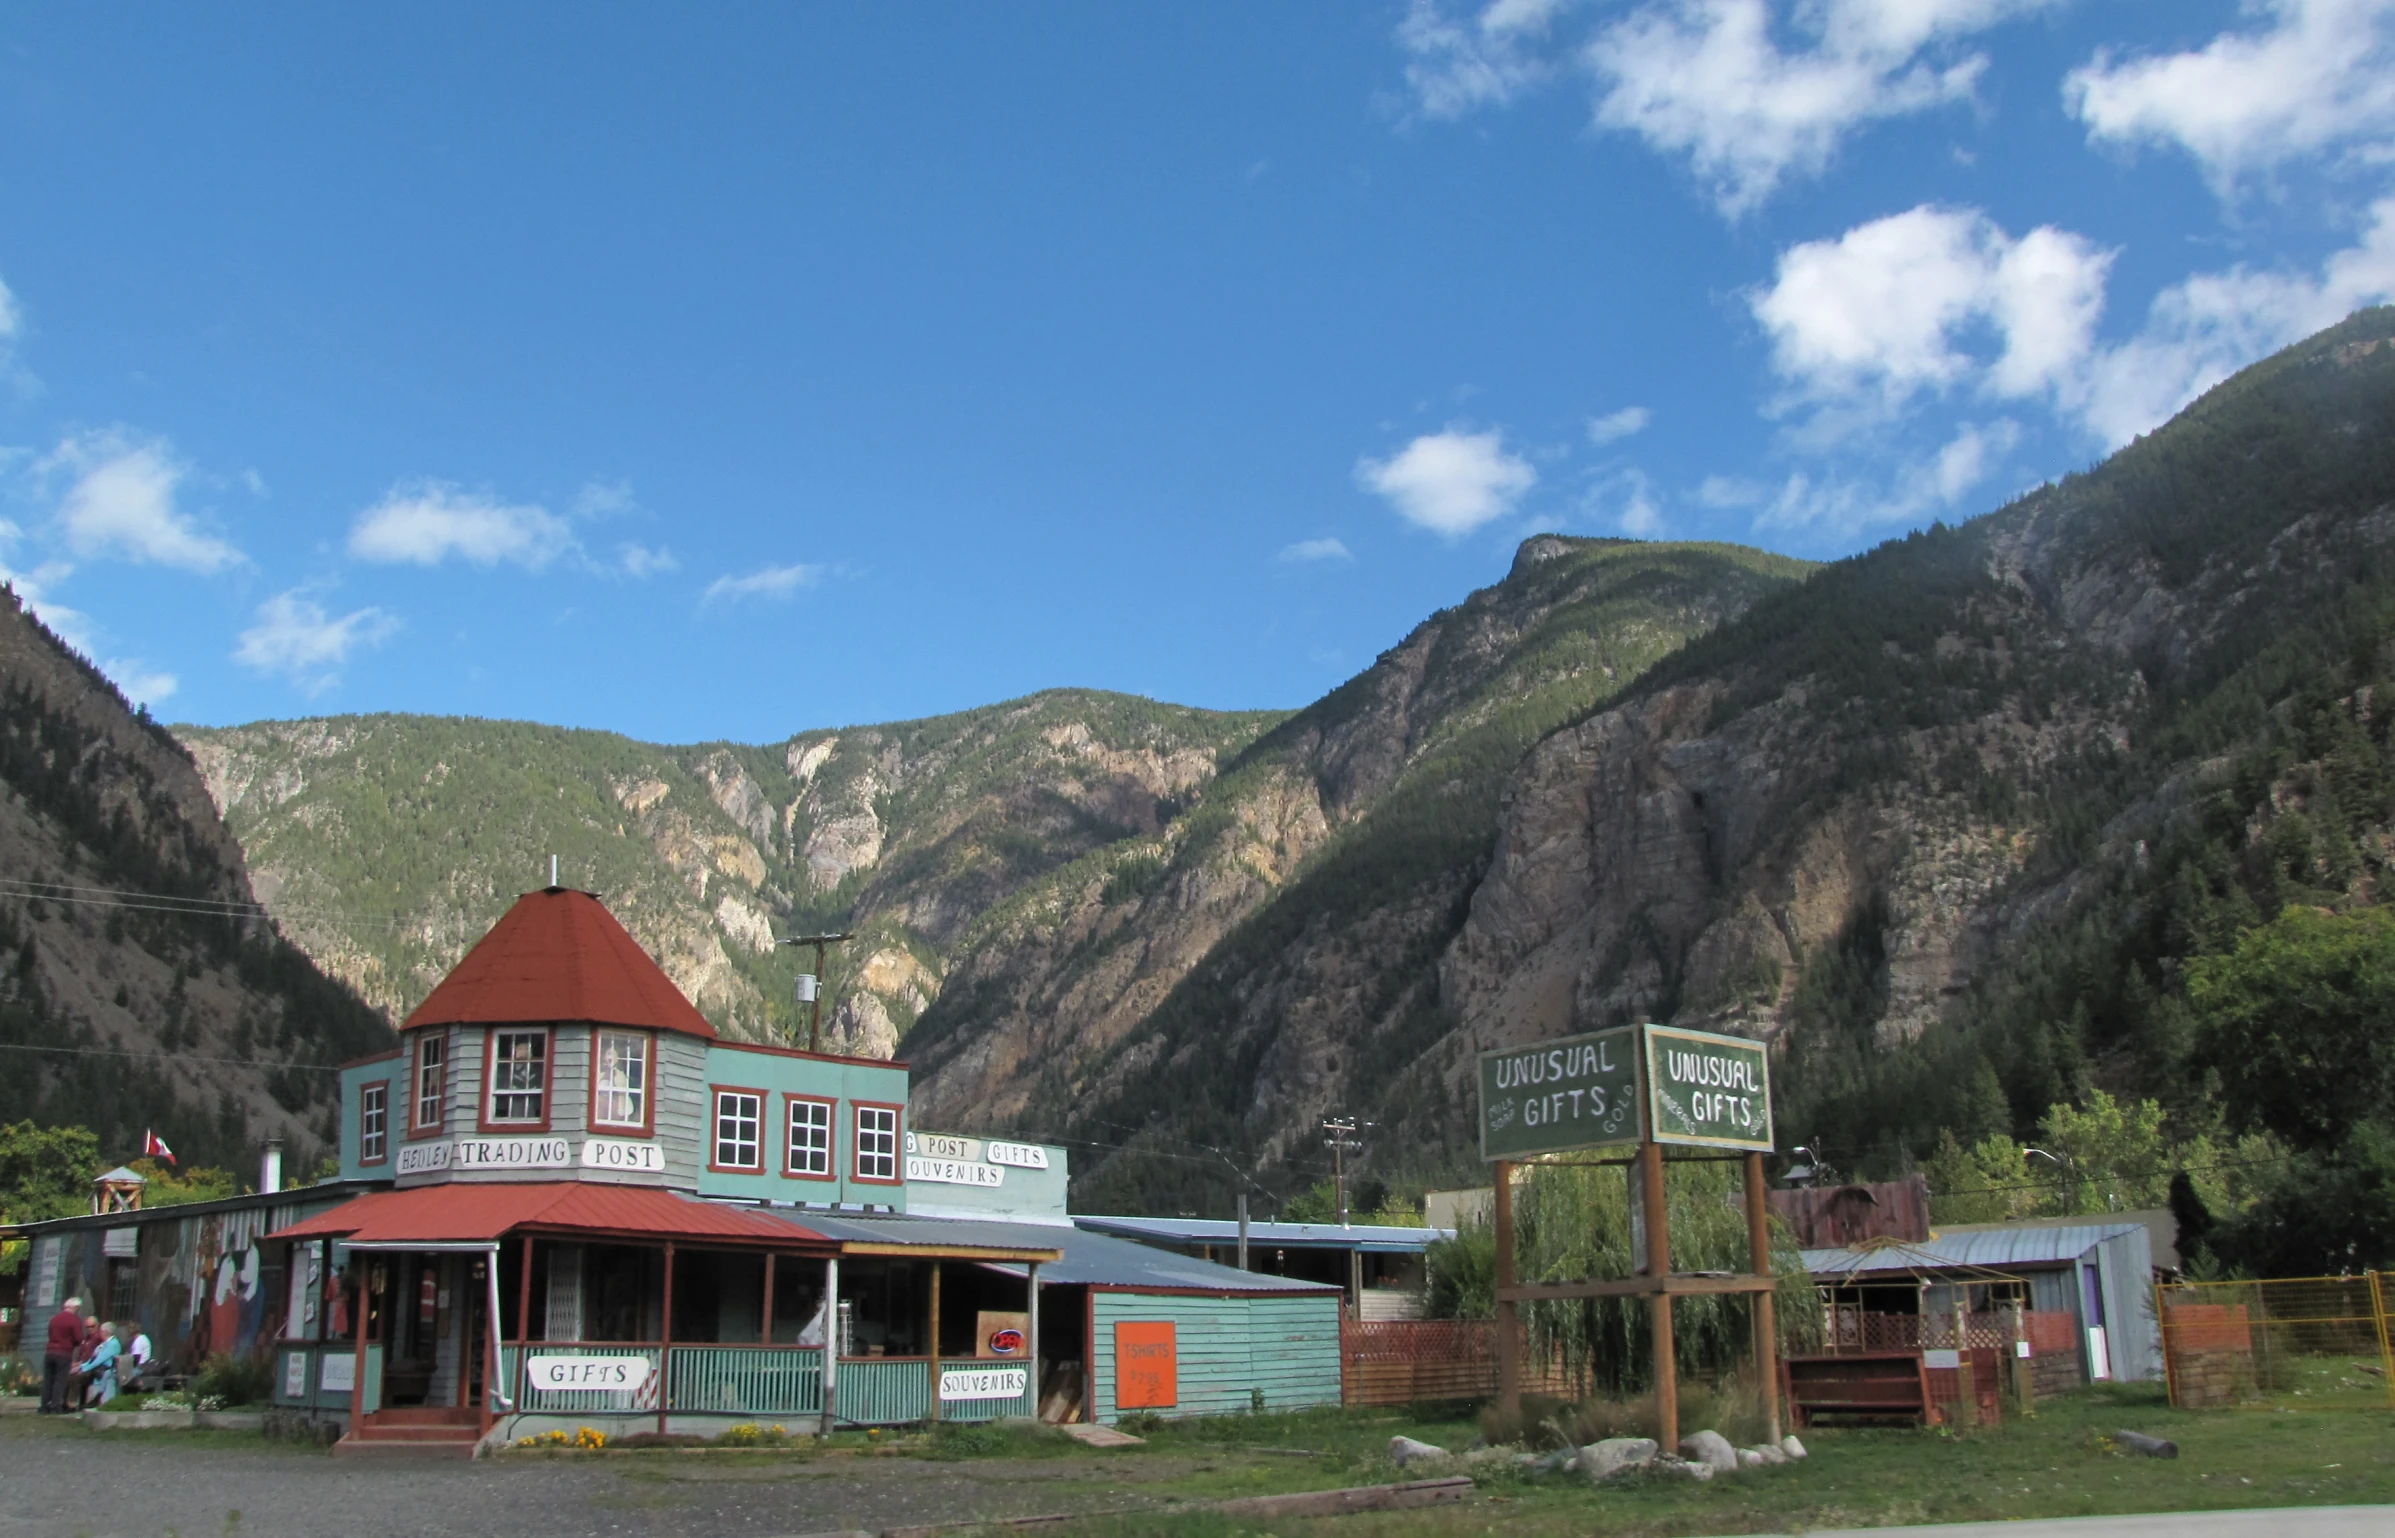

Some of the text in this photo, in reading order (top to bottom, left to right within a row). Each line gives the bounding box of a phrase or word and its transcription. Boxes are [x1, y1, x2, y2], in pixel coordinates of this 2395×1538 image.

[1496, 1041, 1616, 1089] UNUSUAL
[1668, 1049, 1759, 1092] UNUSUAL
[1524, 1086, 1606, 1126] GIFTS
[1602, 1084, 1634, 1134] GOLD
[1692, 1090, 1751, 1127] GIFTS
[402, 1141, 655, 1170] HEDLEY TRADING POST
[928, 1137, 968, 1157] POST
[993, 1144, 1041, 1164] GIFTS
[910, 1160, 998, 1183] OUVENIRS
[550, 1364, 627, 1383] GIFTS
[942, 1373, 1025, 1393] SOUVENIRS
